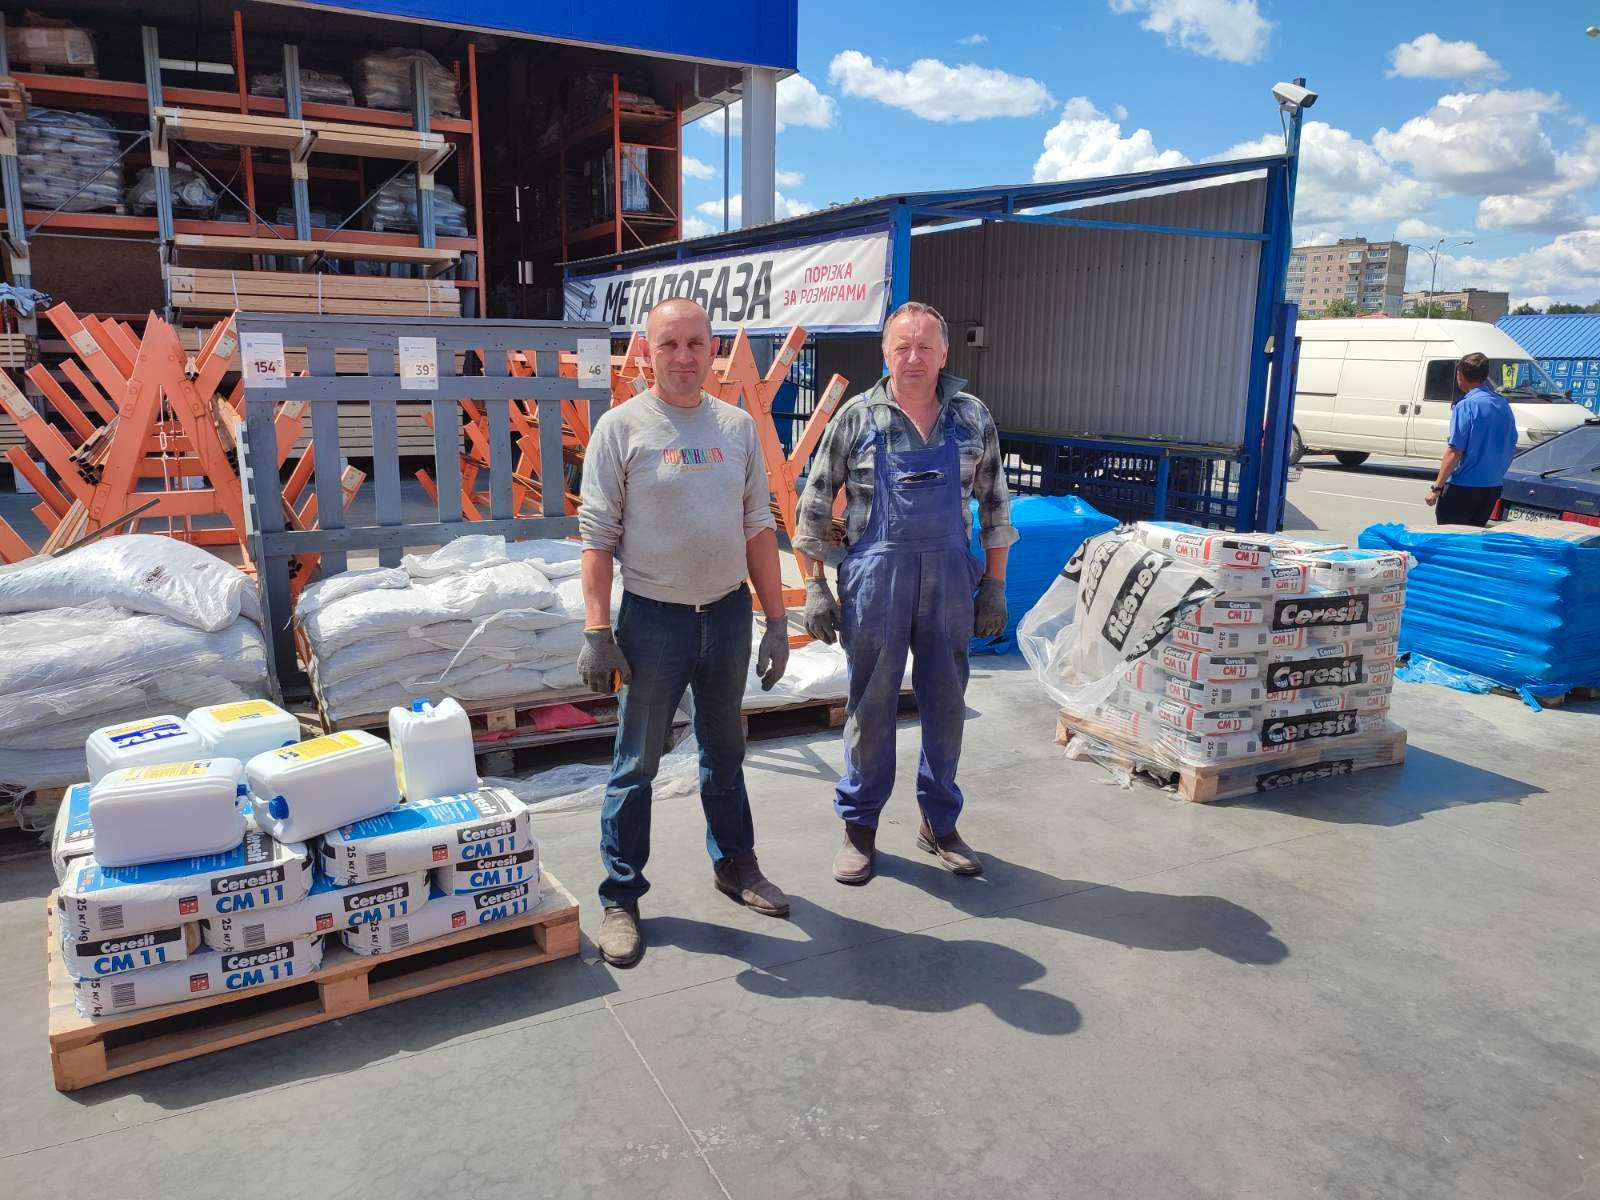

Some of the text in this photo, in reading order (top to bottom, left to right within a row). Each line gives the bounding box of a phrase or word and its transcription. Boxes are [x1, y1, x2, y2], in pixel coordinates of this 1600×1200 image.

[805, 262, 853, 284] ПОРІЗКА
[784, 284, 867, 306] ЗА РОЗМІРАМИ
[254, 361, 276, 373] 154
[415, 364, 430, 376] 39
[588, 364, 602, 376] 46
[1237, 542, 1261, 551] Ceresit
[1235, 550, 1249, 561] CM
[1229, 601, 1250, 609] Ceresit
[1280, 598, 1365, 625] Ceresit
[1227, 610, 1242, 619] CM
[1177, 629, 1189, 640] CM
[1272, 635, 1285, 645] CM
[1319, 645, 1343, 657] Ceresit
[1163, 656, 1176, 668] CM
[1225, 657, 1246, 665] Ceresit
[1223, 666, 1236, 675] CM
[1273, 660, 1359, 688] Ceresit
[1168, 684, 1181, 695] CM
[1315, 698, 1339, 709] Ceresit
[1217, 720, 1231, 730] CM
[1267, 713, 1352, 742] Ceresit
[1261, 761, 1348, 788] Ceresit
[461, 822, 513, 841] Ceresit
[346, 845, 356, 859] 25
[461, 843, 497, 860] CM
[499, 836, 515, 853] 11
[477, 855, 518, 870] Ceresit
[217, 869, 279, 893] Ceresit
[469, 866, 523, 887] CM 11
[216, 892, 255, 914] CM
[261, 884, 284, 904] 11
[350, 885, 405, 908] Ceresit
[479, 885, 526, 906] Ceresit
[77, 898, 88, 912] 25
[479, 907, 507, 924] CM
[511, 898, 528, 917] 11
[348, 909, 382, 927] CM
[388, 900, 408, 918] 11
[222, 918, 232, 931] 25
[370, 921, 380, 933] 25
[100, 933, 155, 954] Ceresit
[94, 946, 166, 975] CM 11
[227, 946, 289, 969] Ceresit
[226, 968, 264, 990] CM
[269, 960, 294, 980] 11
